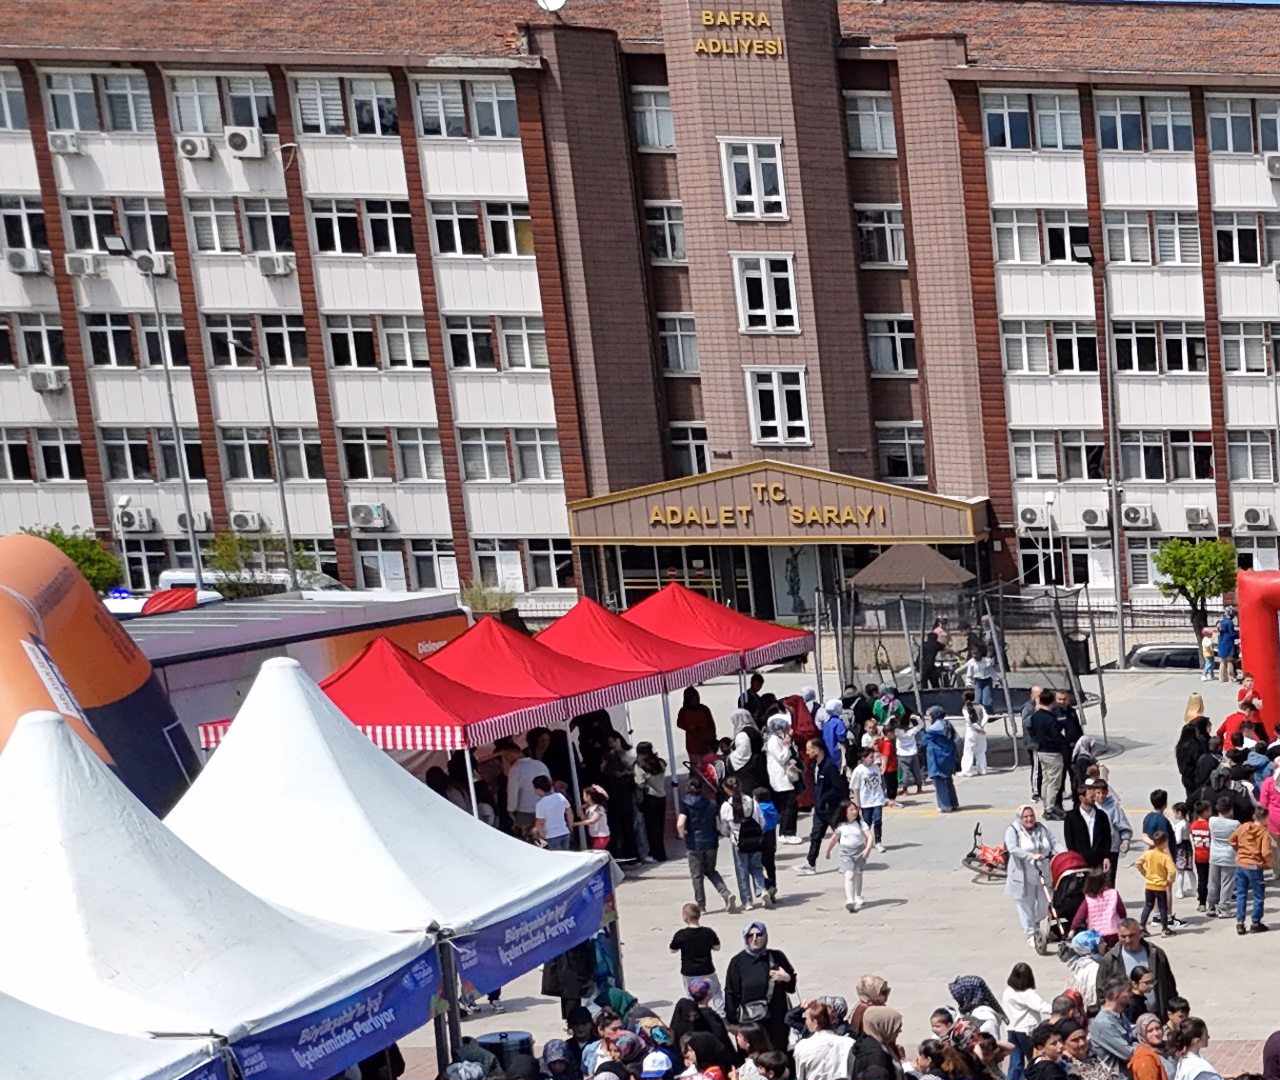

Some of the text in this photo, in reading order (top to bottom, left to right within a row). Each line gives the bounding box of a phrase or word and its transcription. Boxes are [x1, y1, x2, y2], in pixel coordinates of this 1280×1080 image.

[701, 10, 771, 27] BAFRA
[695, 36, 783, 55] ADLİYESİ
[752, 482, 791, 502] T.C.
[650, 505, 886, 525] ADALET SARAYI
[354, 1007, 396, 1038] Parlıyor
